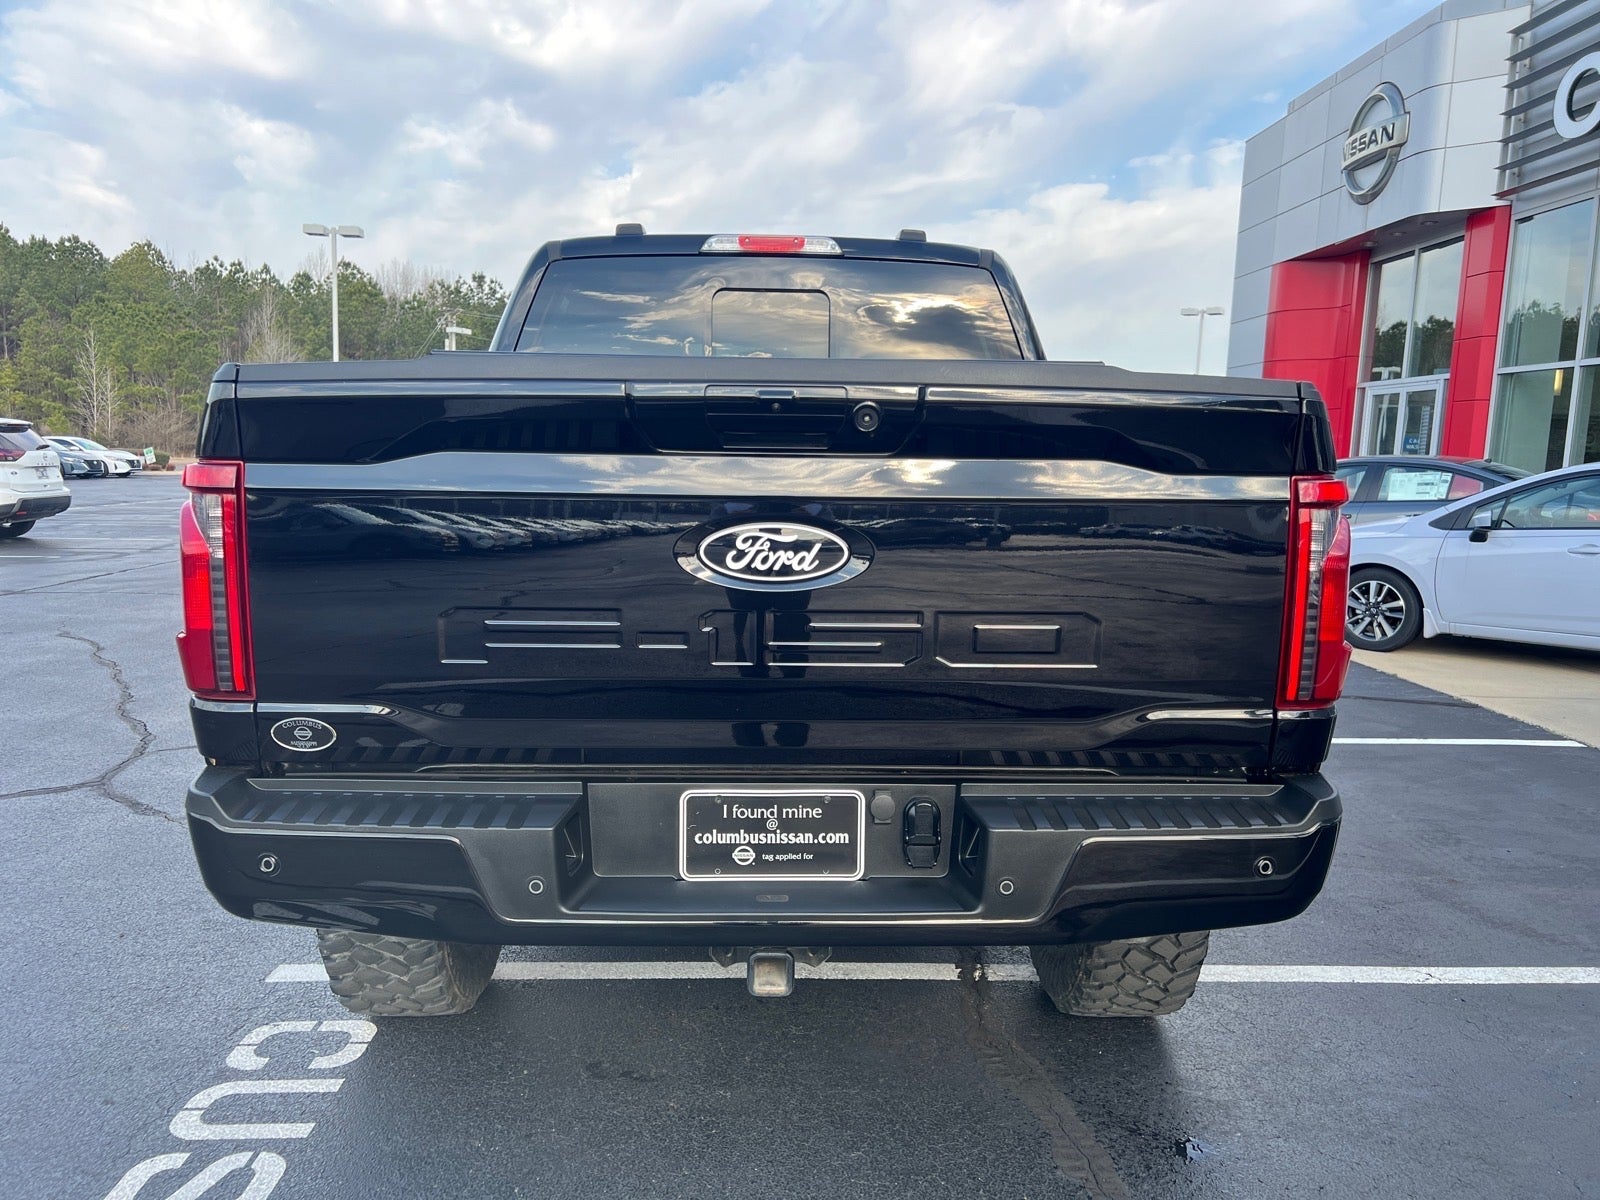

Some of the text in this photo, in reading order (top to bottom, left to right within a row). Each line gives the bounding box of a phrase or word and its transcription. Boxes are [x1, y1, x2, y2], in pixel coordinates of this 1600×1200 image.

[725, 532, 822, 572] Ford
[438, 607, 1102, 670] F-150
[281, 720, 322, 730] COLUMBUS
[723, 804, 822, 819] I found mine
[766, 818, 778, 830] @
[694, 829, 849, 844] columbusnissan.com
[762, 853, 774, 861] tag
[775, 853, 801, 861] applied
